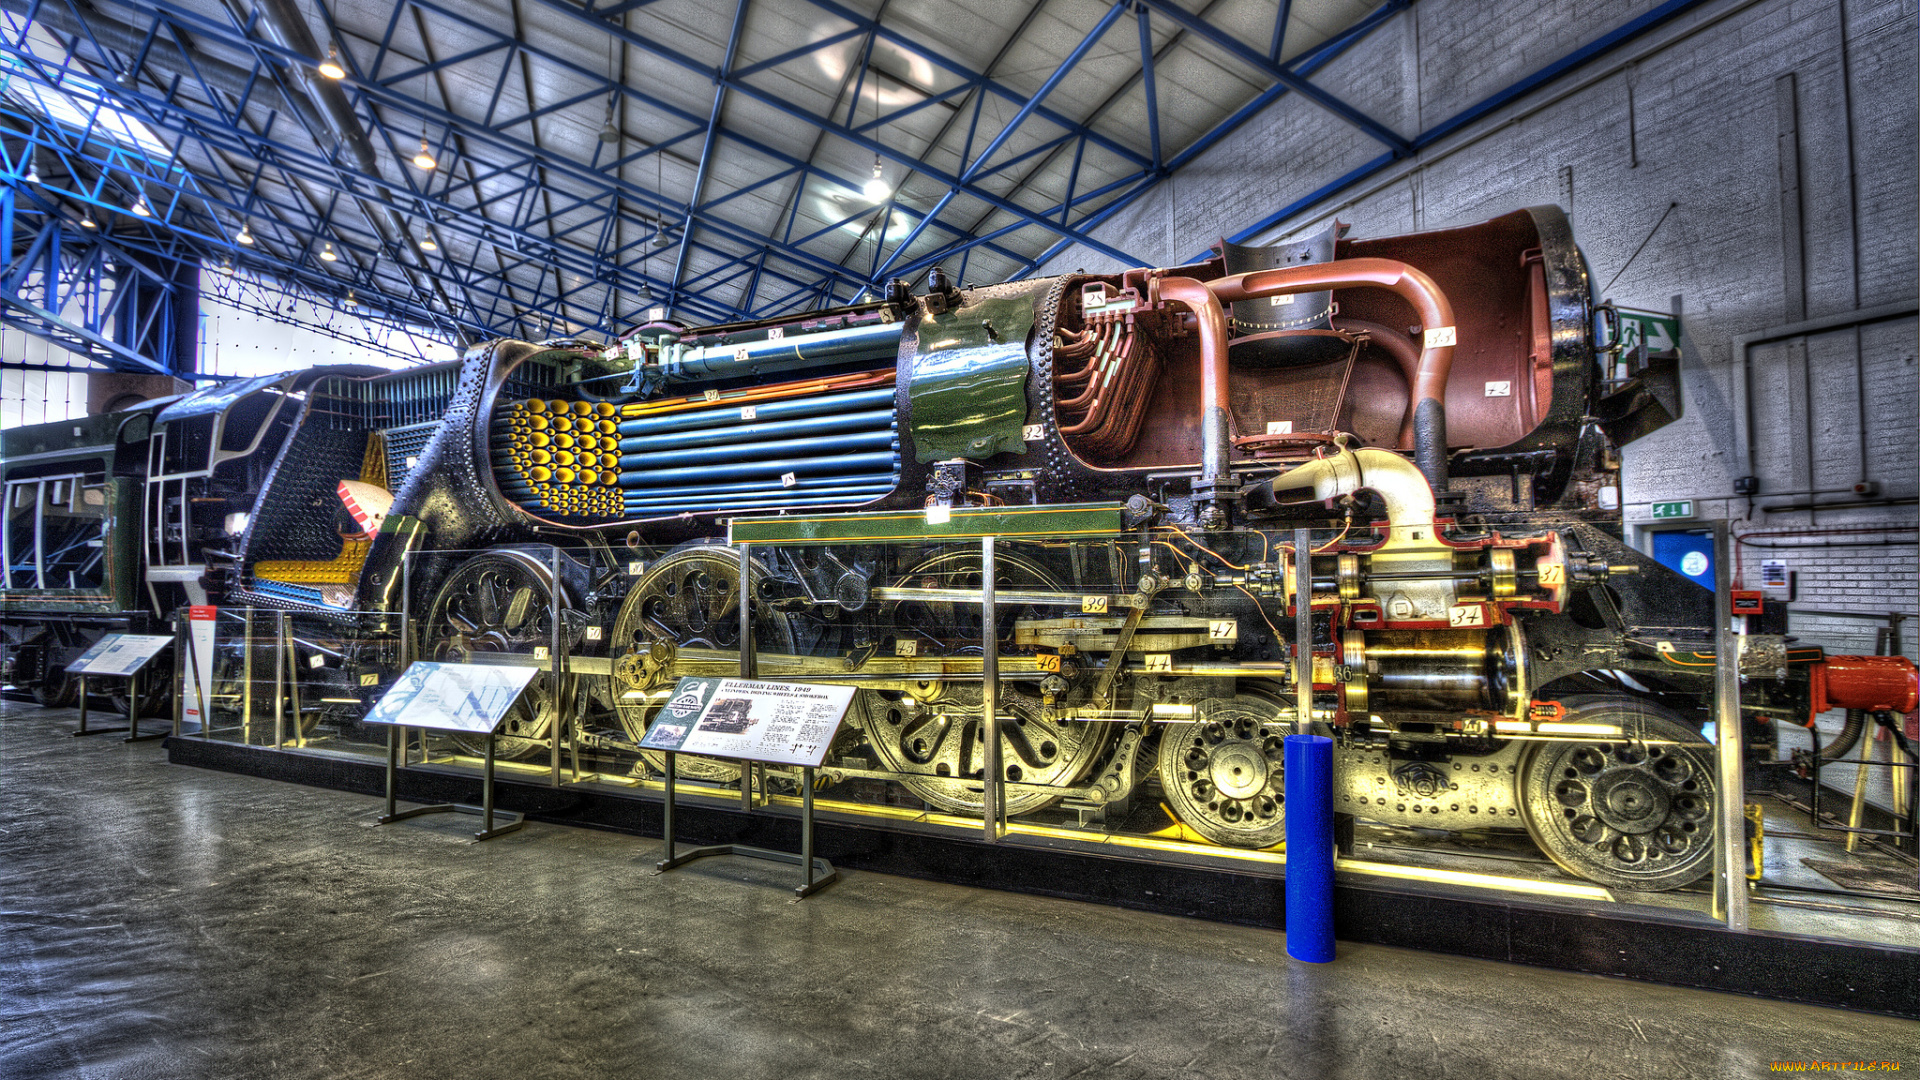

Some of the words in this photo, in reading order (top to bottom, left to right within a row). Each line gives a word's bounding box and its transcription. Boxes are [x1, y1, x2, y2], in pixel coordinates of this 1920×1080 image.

[882, 309, 891, 322] 8
[1427, 327, 1454, 345] 33
[1486, 382, 1509, 395] 42
[1022, 425, 1043, 440] 32
[1540, 564, 1562, 583] 37
[1083, 596, 1106, 612] 39
[1451, 607, 1481, 625] 34
[1209, 622, 1236, 638] 47
[897, 641, 916, 654] 45
[1037, 654, 1059, 671] 46
[1146, 655, 1170, 671] 44
[362, 674, 377, 685] 17
[1334, 664, 1353, 682] 36
[724, 681, 766, 690] ELLERMAN
